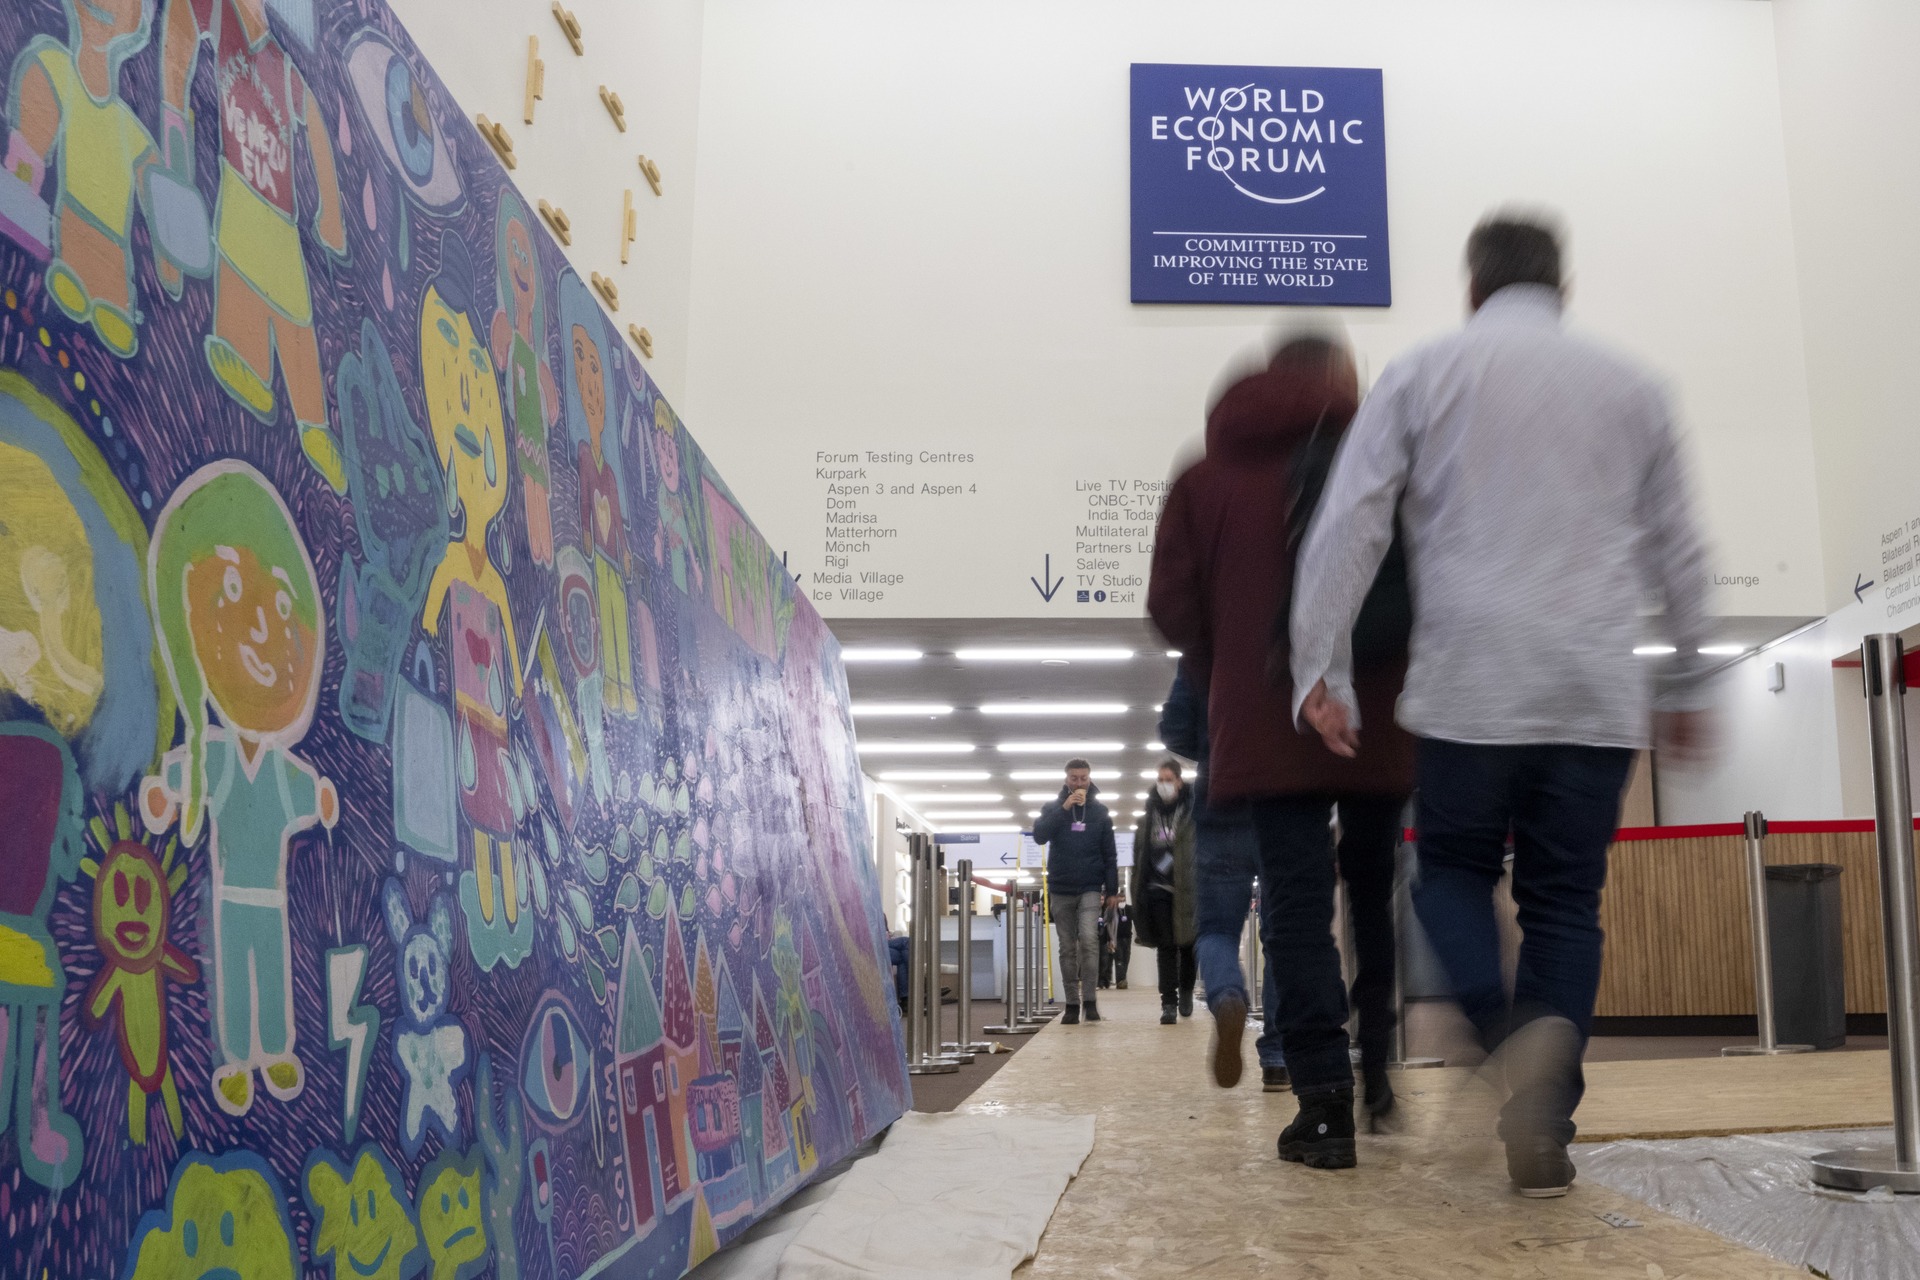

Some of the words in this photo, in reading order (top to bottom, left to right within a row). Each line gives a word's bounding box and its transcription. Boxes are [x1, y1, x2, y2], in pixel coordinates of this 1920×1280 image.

[1184, 86, 1325, 114] WORLD
[1152, 115, 1364, 145] ECONOMIC
[1186, 146, 1327, 174] FORUM
[1184, 238, 1305, 254] COMMITTED
[1310, 240, 1337, 254] TO
[1153, 255, 1264, 270] IMPROVING
[1268, 257, 1308, 271] THE
[1313, 258, 1369, 272] STATE
[1188, 272, 1215, 286] OF
[1219, 272, 1259, 287] THE
[1263, 273, 1335, 288] WORLD
[816, 451, 859, 463] Forum
[865, 451, 913, 466] Testing
[919, 451, 975, 463] Centres
[816, 468, 867, 481] Kurpark
[827, 483, 870, 497] Aspen
[875, 483, 885, 495] 3
[890, 483, 915, 495] and
[920, 483, 963, 497] Aspen
[968, 483, 978, 495] 4
[1075, 480, 1102, 492] Live
[1108, 480, 1128, 492] TV
[826, 498, 857, 510] Dom
[826, 512, 878, 524] Madrisa
[1088, 509, 1119, 521] India
[1123, 509, 1162, 524] Today
[825, 526, 898, 539] Matterhorn
[1075, 526, 1149, 538] Multilateral
[1881, 527, 1903, 547] Aspen
[825, 540, 871, 553] Mönch
[1075, 542, 1132, 554] Partners
[1882, 538, 1912, 564] Bilateral
[824, 554, 849, 570] Rigi
[1076, 557, 1120, 571] Salève
[1883, 557, 1913, 582] Bilateral
[813, 572, 853, 584] Media
[859, 572, 904, 587] Village
[1076, 574, 1096, 587] TV
[1102, 574, 1143, 587] Studio
[1713, 574, 1760, 588] Lounge
[812, 588, 833, 601] Ice
[839, 588, 884, 604] Village
[1110, 591, 1136, 603] Exit
